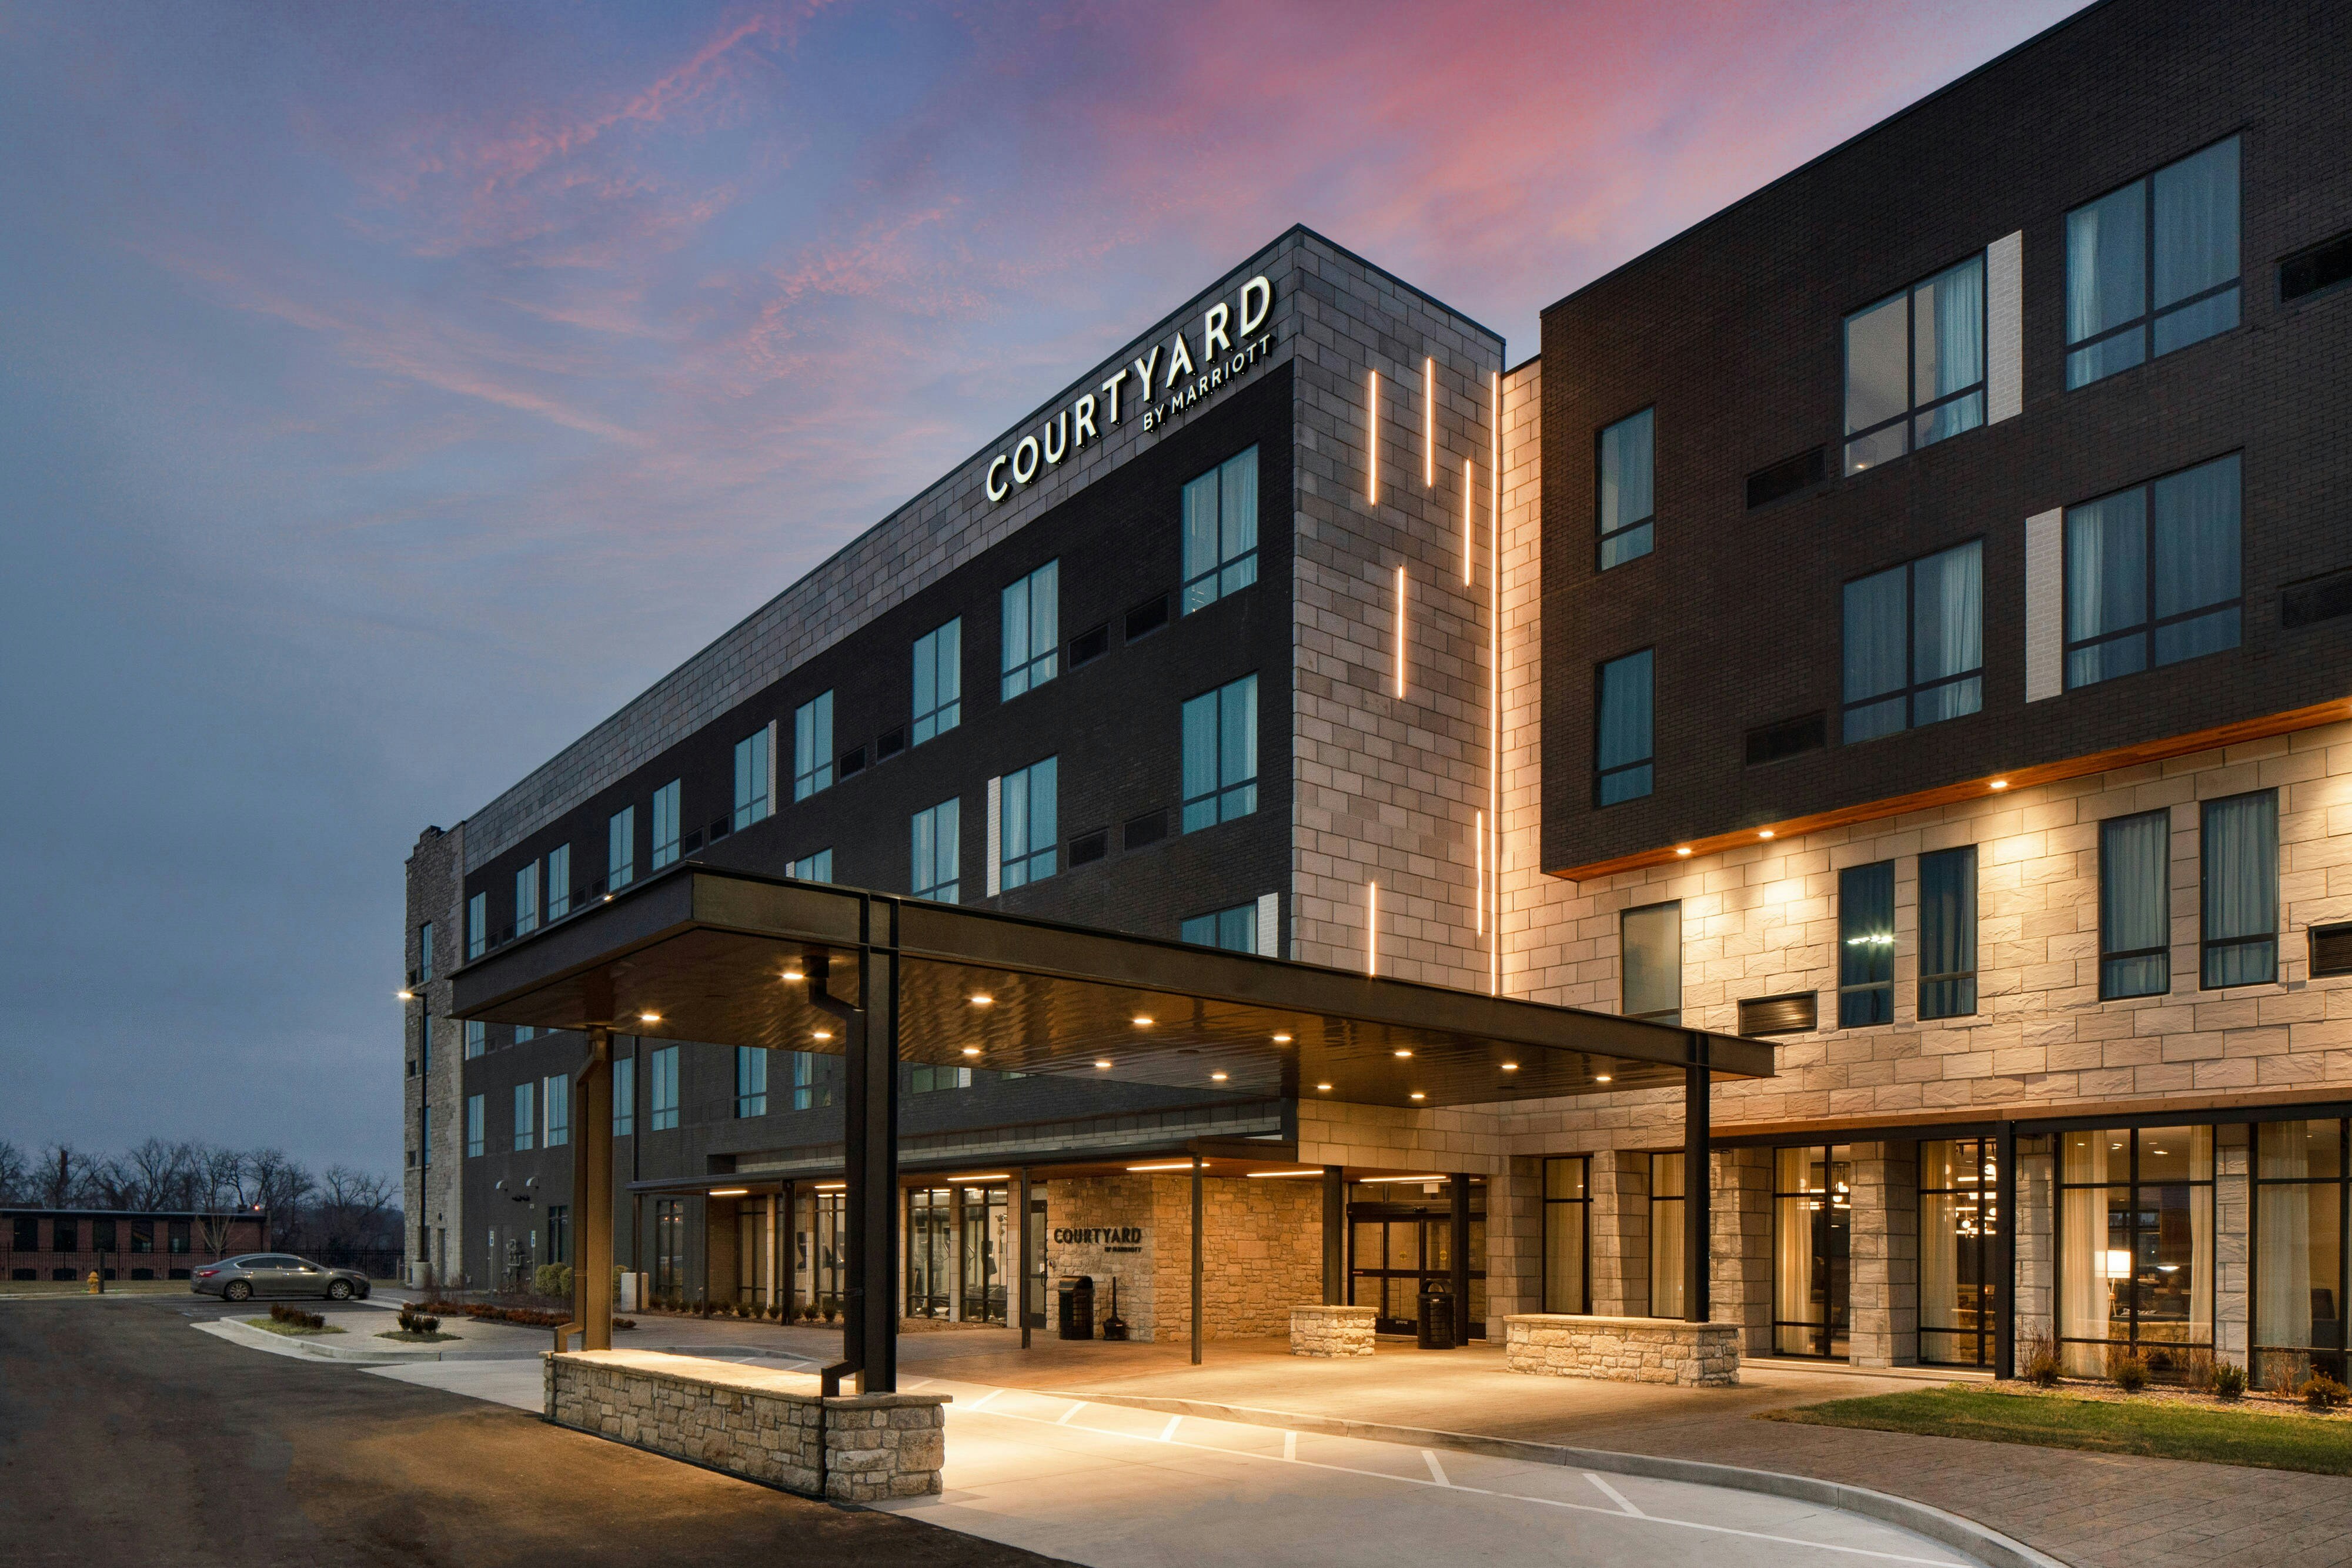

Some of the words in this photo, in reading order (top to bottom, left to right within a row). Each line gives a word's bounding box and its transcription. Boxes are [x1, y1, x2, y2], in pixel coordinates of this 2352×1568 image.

[985, 275, 1273, 503] COURTYARD
[1144, 404, 1165, 432] BY
[1171, 333, 1271, 415] MARRIOTT
[1054, 1227, 1141, 1243] COURTYARD
